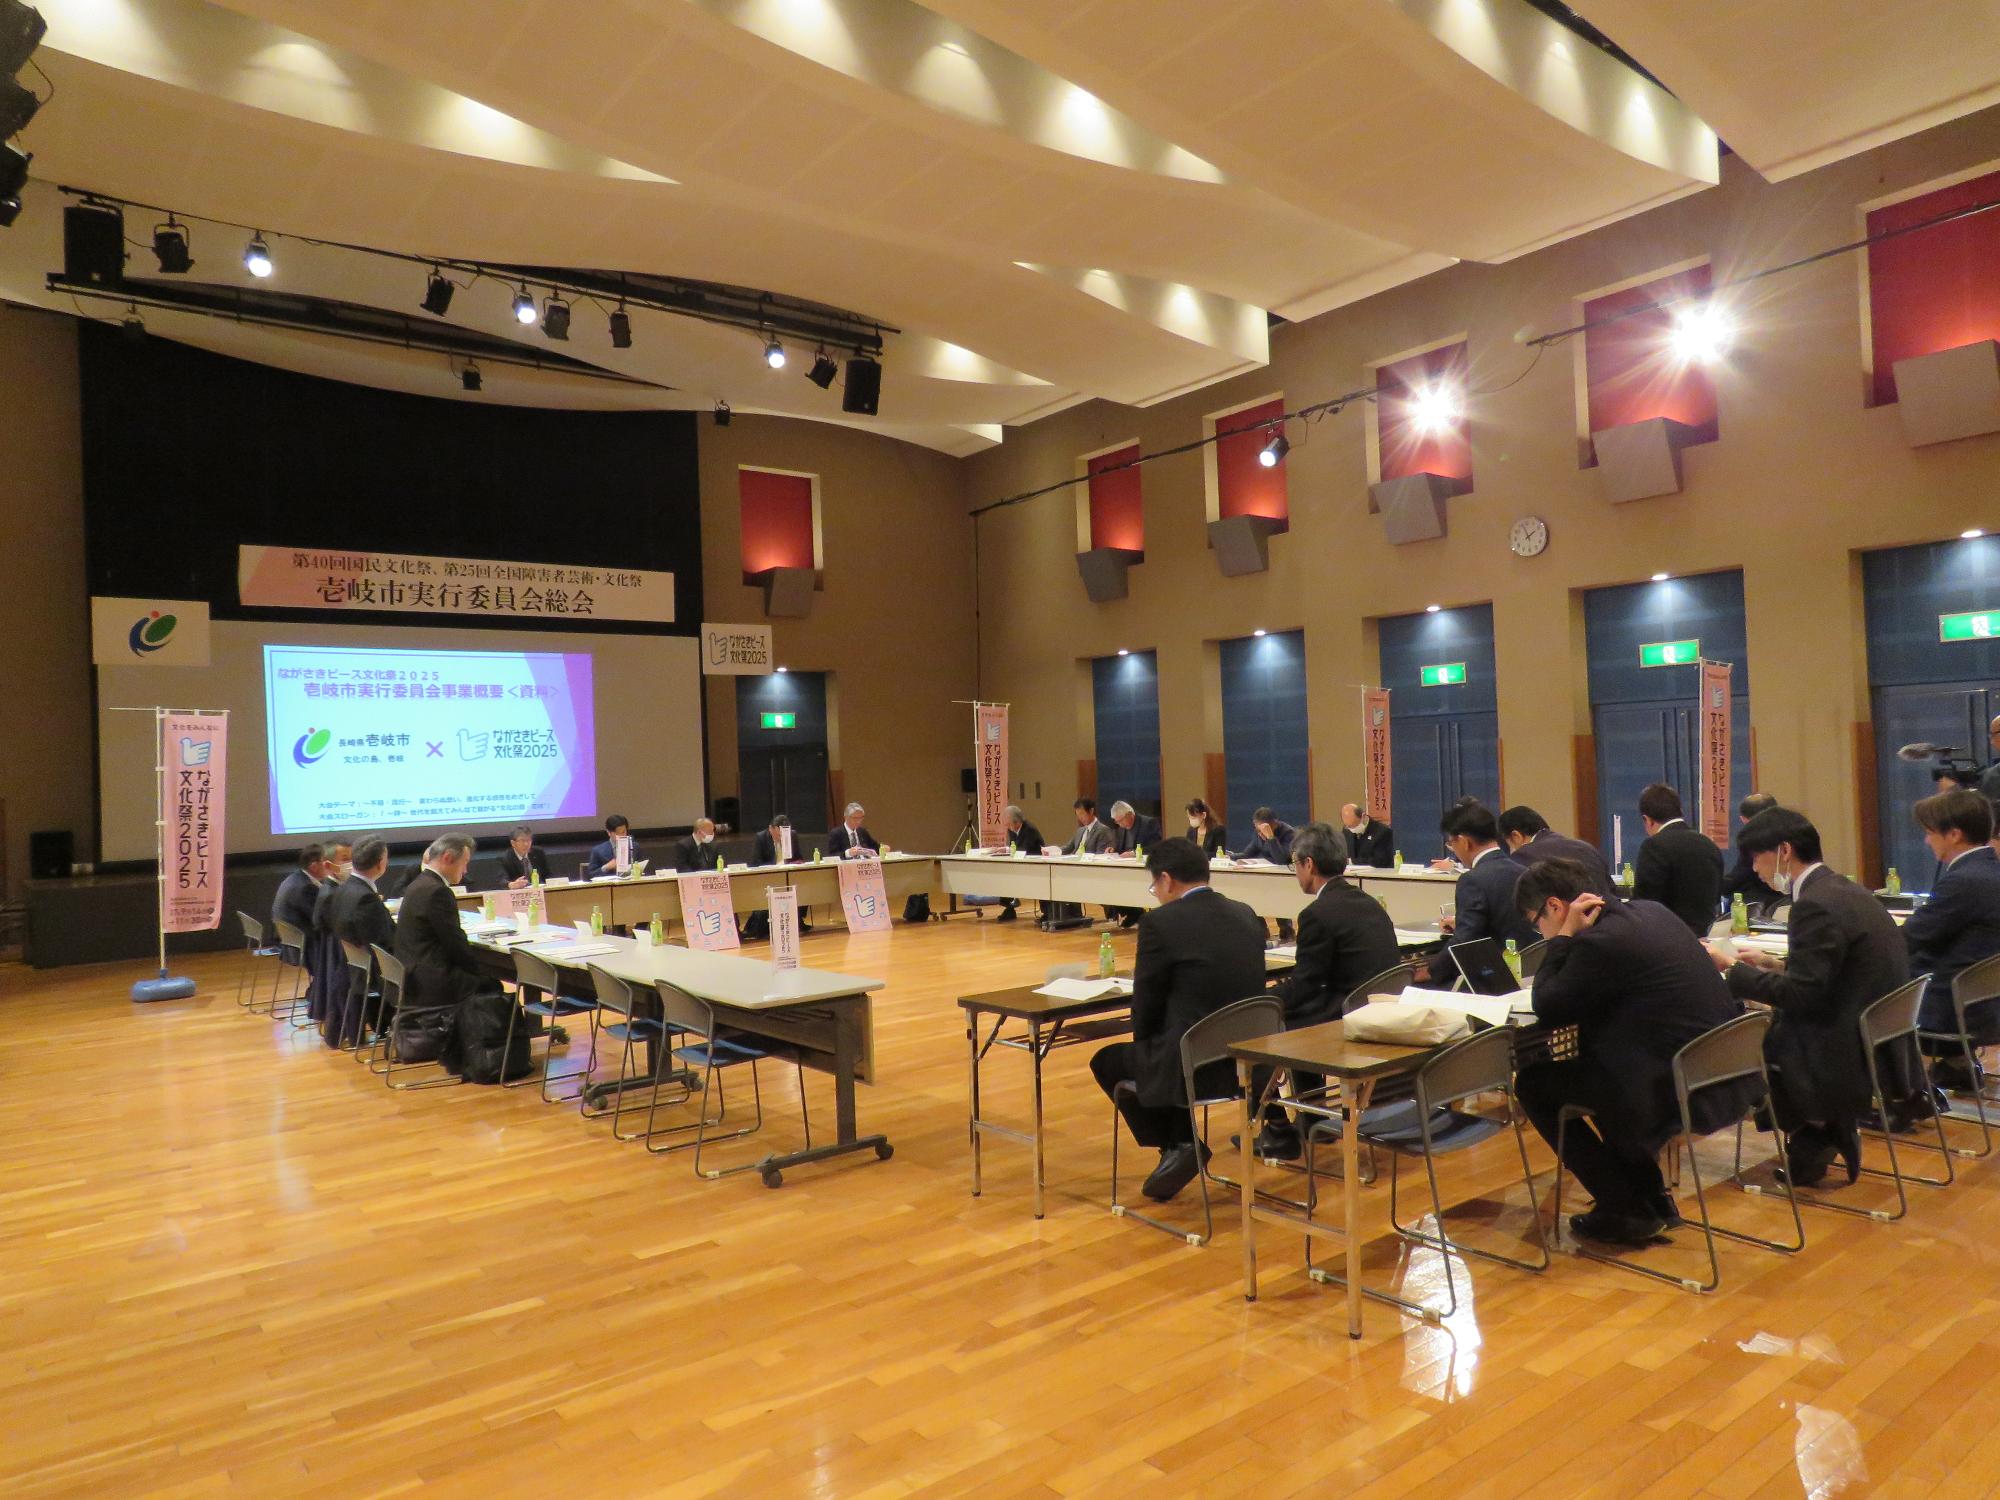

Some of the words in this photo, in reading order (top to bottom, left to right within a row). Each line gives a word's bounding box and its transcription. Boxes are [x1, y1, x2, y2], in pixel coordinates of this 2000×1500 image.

[316, 576, 594, 615] 壱岐市実行委員会総会
[729, 634, 766, 650] ながさきピース
[730, 651, 768, 665] 文化祭2025
[493, 729, 554, 744] ながさきピース
[494, 744, 558, 759] 文化祭2025
[984, 743, 992, 825] 文化祭2025
[994, 744, 1002, 825] ながさきピース
[1379, 729, 1387, 811] ながさきピース
[179, 770, 193, 889] 文化祭2025
[196, 770, 213, 889] ながさきピース
